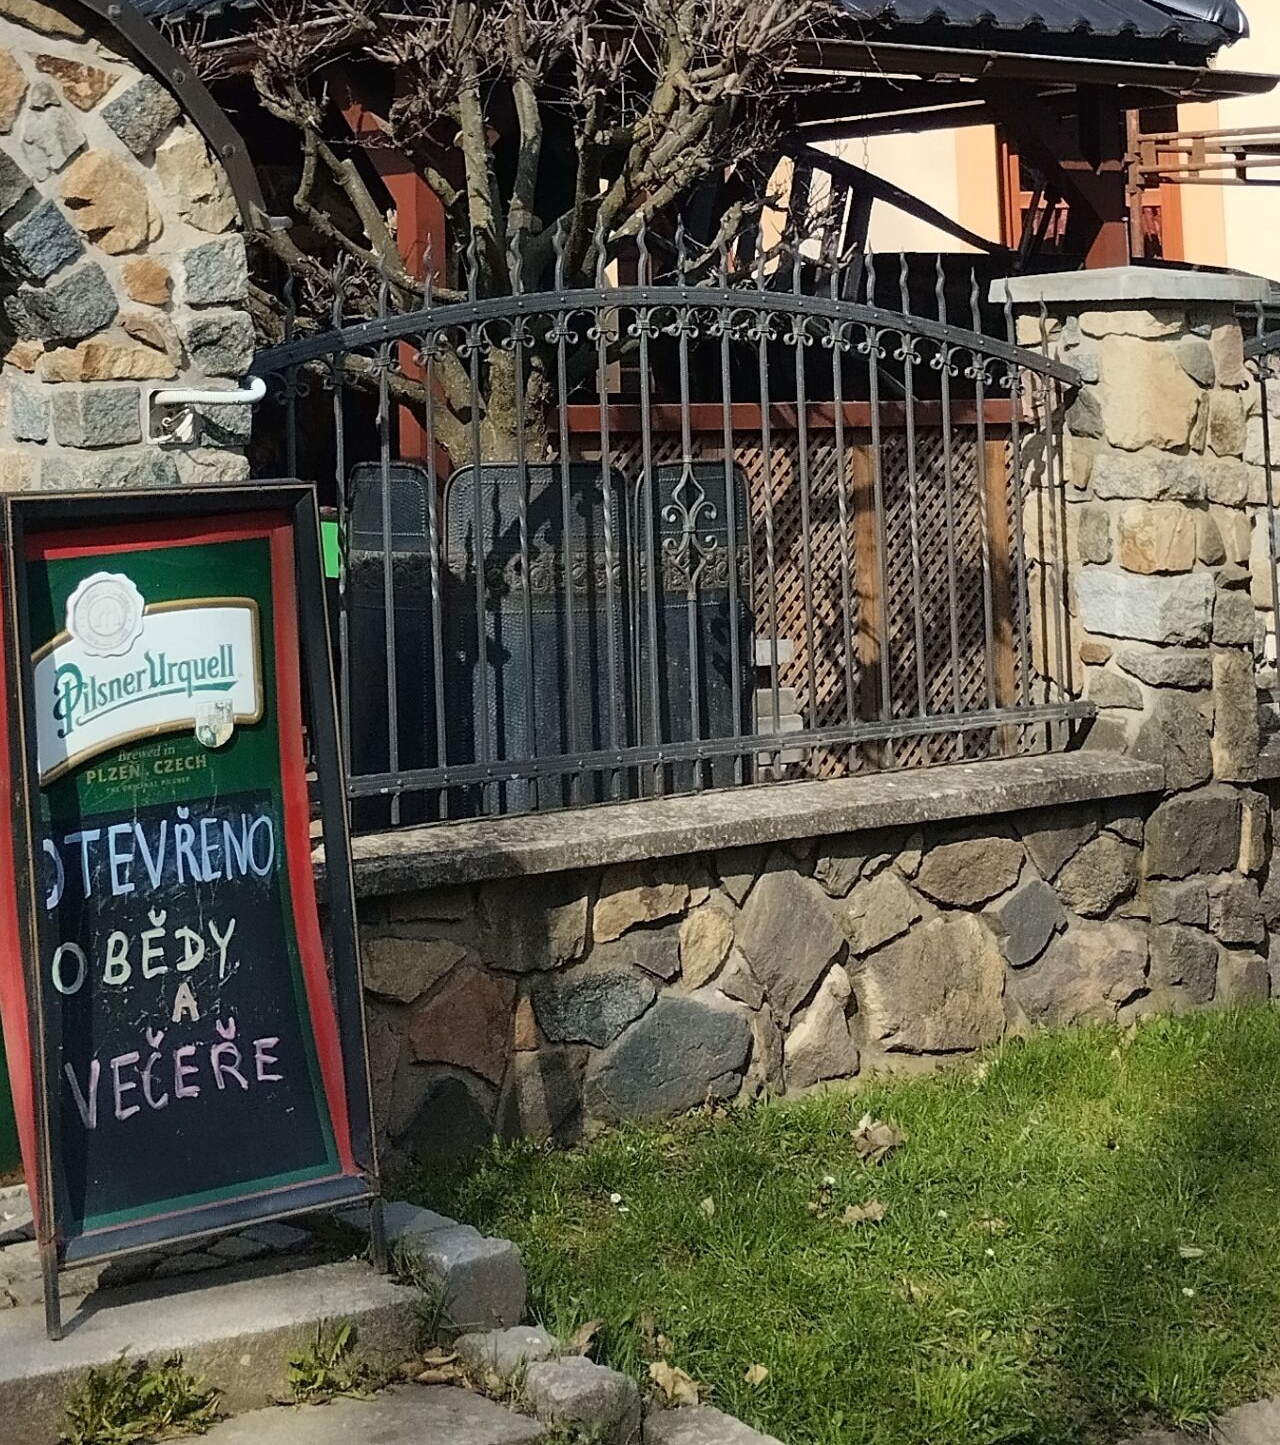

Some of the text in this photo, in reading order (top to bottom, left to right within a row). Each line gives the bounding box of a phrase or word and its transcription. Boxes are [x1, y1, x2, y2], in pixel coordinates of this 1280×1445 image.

[52, 643, 235, 739] Pilsner Urquell
[118, 743, 175, 762] Brewed in
[153, 754, 207, 775] CZECH
[172, 982, 200, 1023] A
[64, 1016, 283, 1130] VEČEŘE
